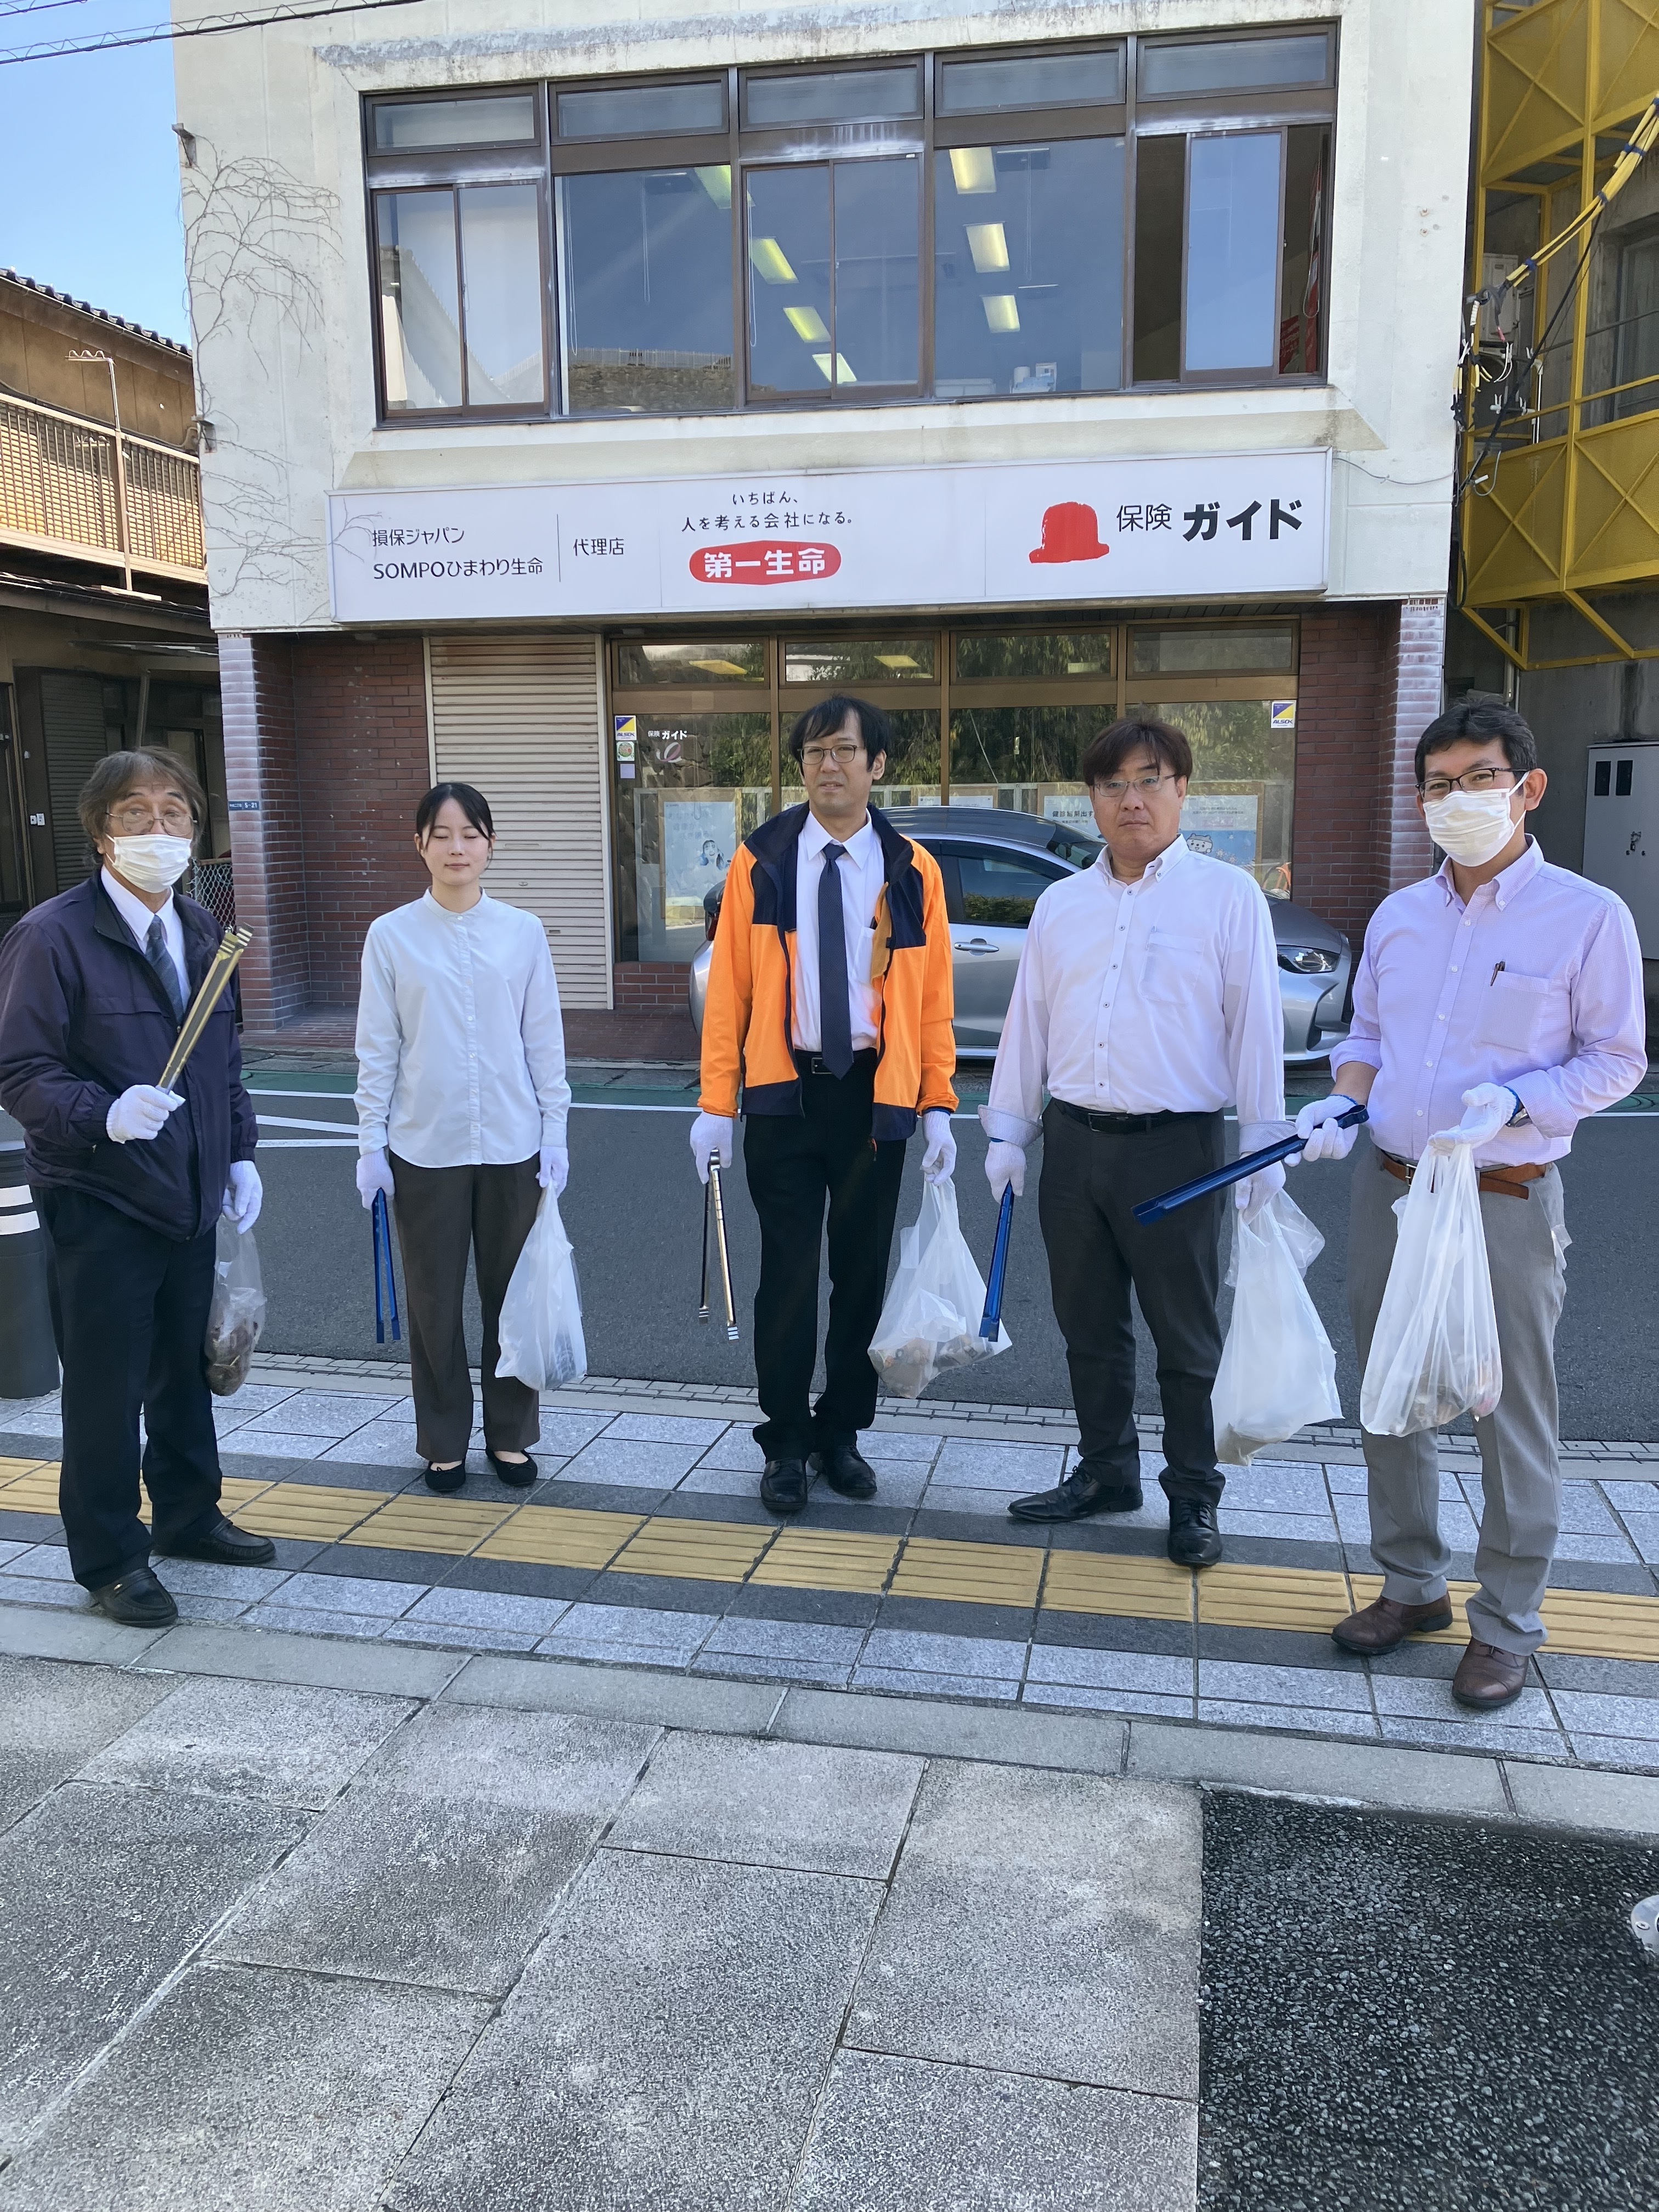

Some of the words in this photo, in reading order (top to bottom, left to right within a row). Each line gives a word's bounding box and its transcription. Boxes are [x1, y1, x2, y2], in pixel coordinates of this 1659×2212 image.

[732, 491, 798, 505] いちばん、
[681, 511, 852, 532] 人を考える会社になる。
[372, 527, 465, 547] 損保ジャパン
[573, 537, 624, 556] 代理店
[374, 557, 543, 579] SOMPOひまわり生命
[704, 548, 825, 578] 第一生命
